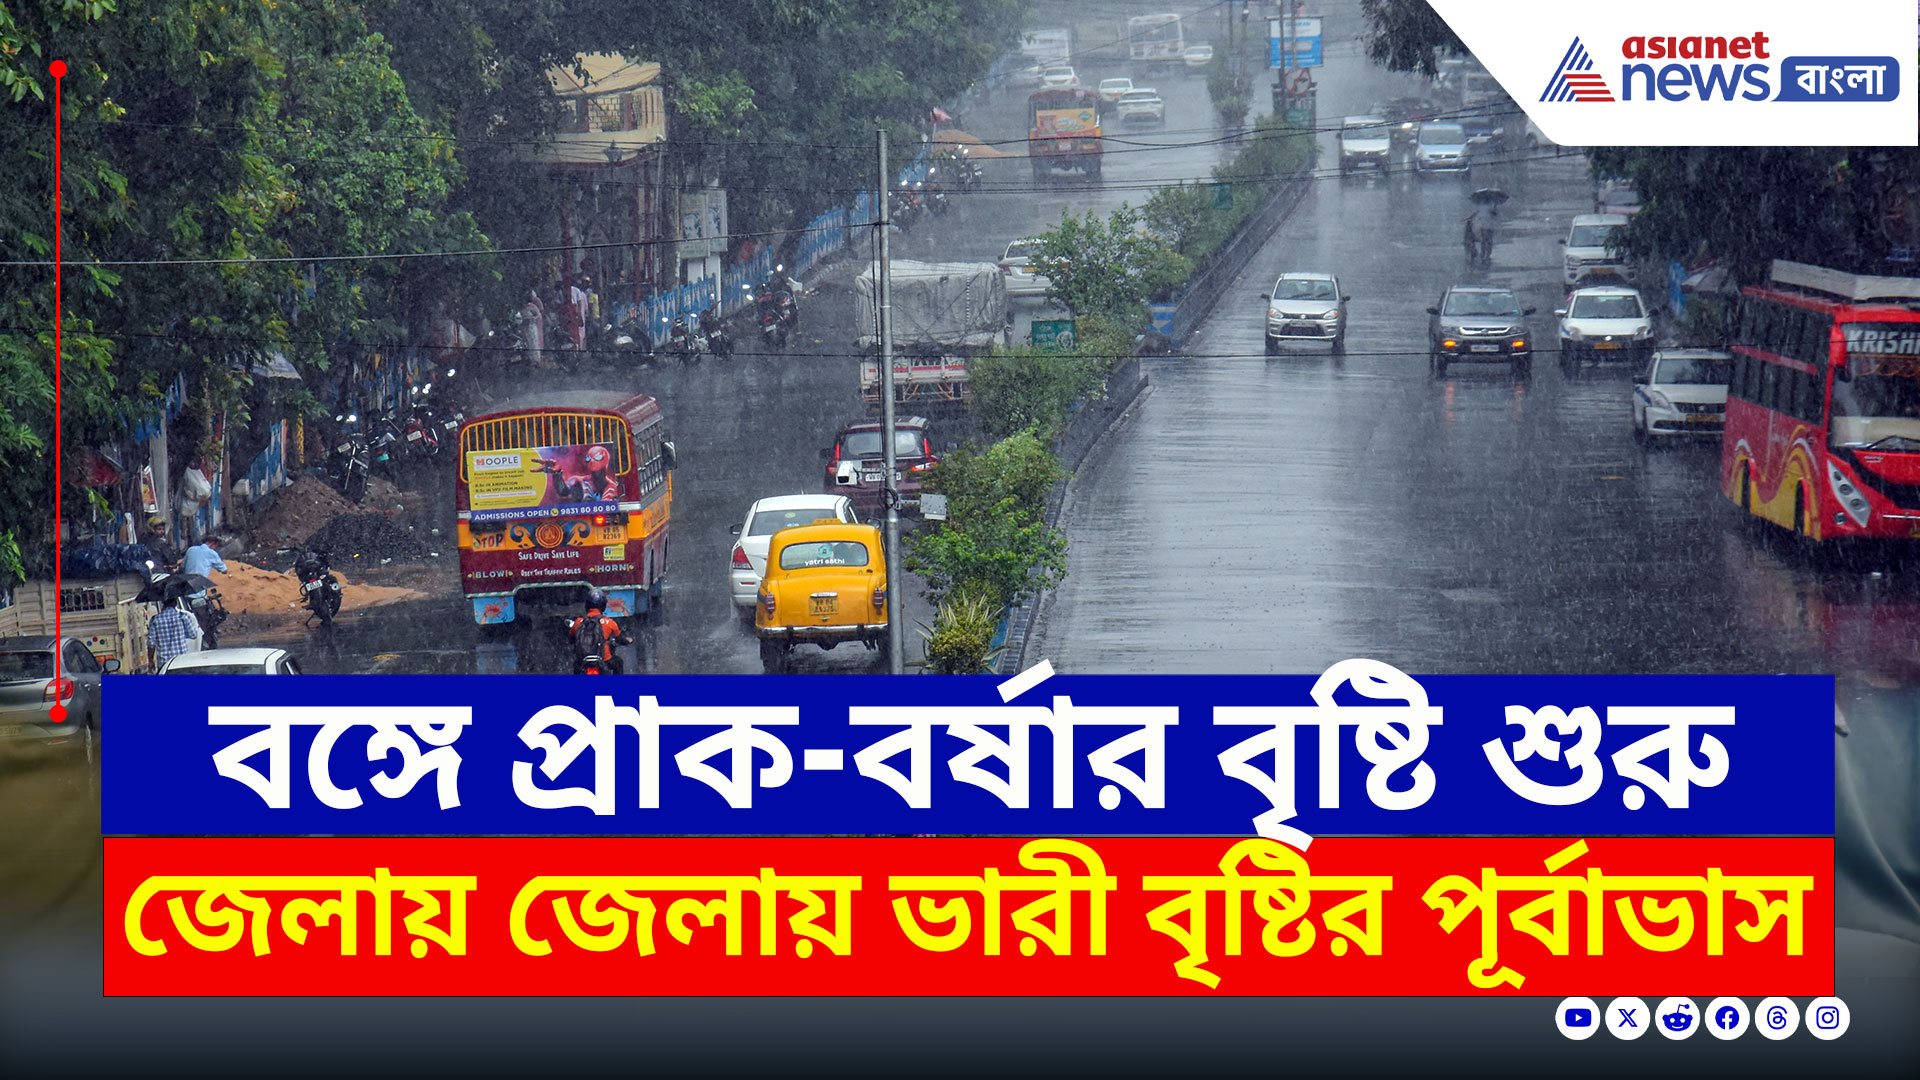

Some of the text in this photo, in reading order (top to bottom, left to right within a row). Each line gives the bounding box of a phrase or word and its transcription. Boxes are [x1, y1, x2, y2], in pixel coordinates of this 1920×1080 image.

[476, 456, 519, 466] MOOPLE
[474, 511, 525, 521] ADMISSIONS
[526, 509, 550, 517] OPEN
[560, 506, 579, 515] 9831
[580, 506, 591, 514] 80
[605, 504, 616, 512] 80
[473, 533, 504, 549] STOP
[804, 558, 824, 567] yatri
[597, 563, 627, 573] HORN
[475, 570, 505, 579] BLOW
